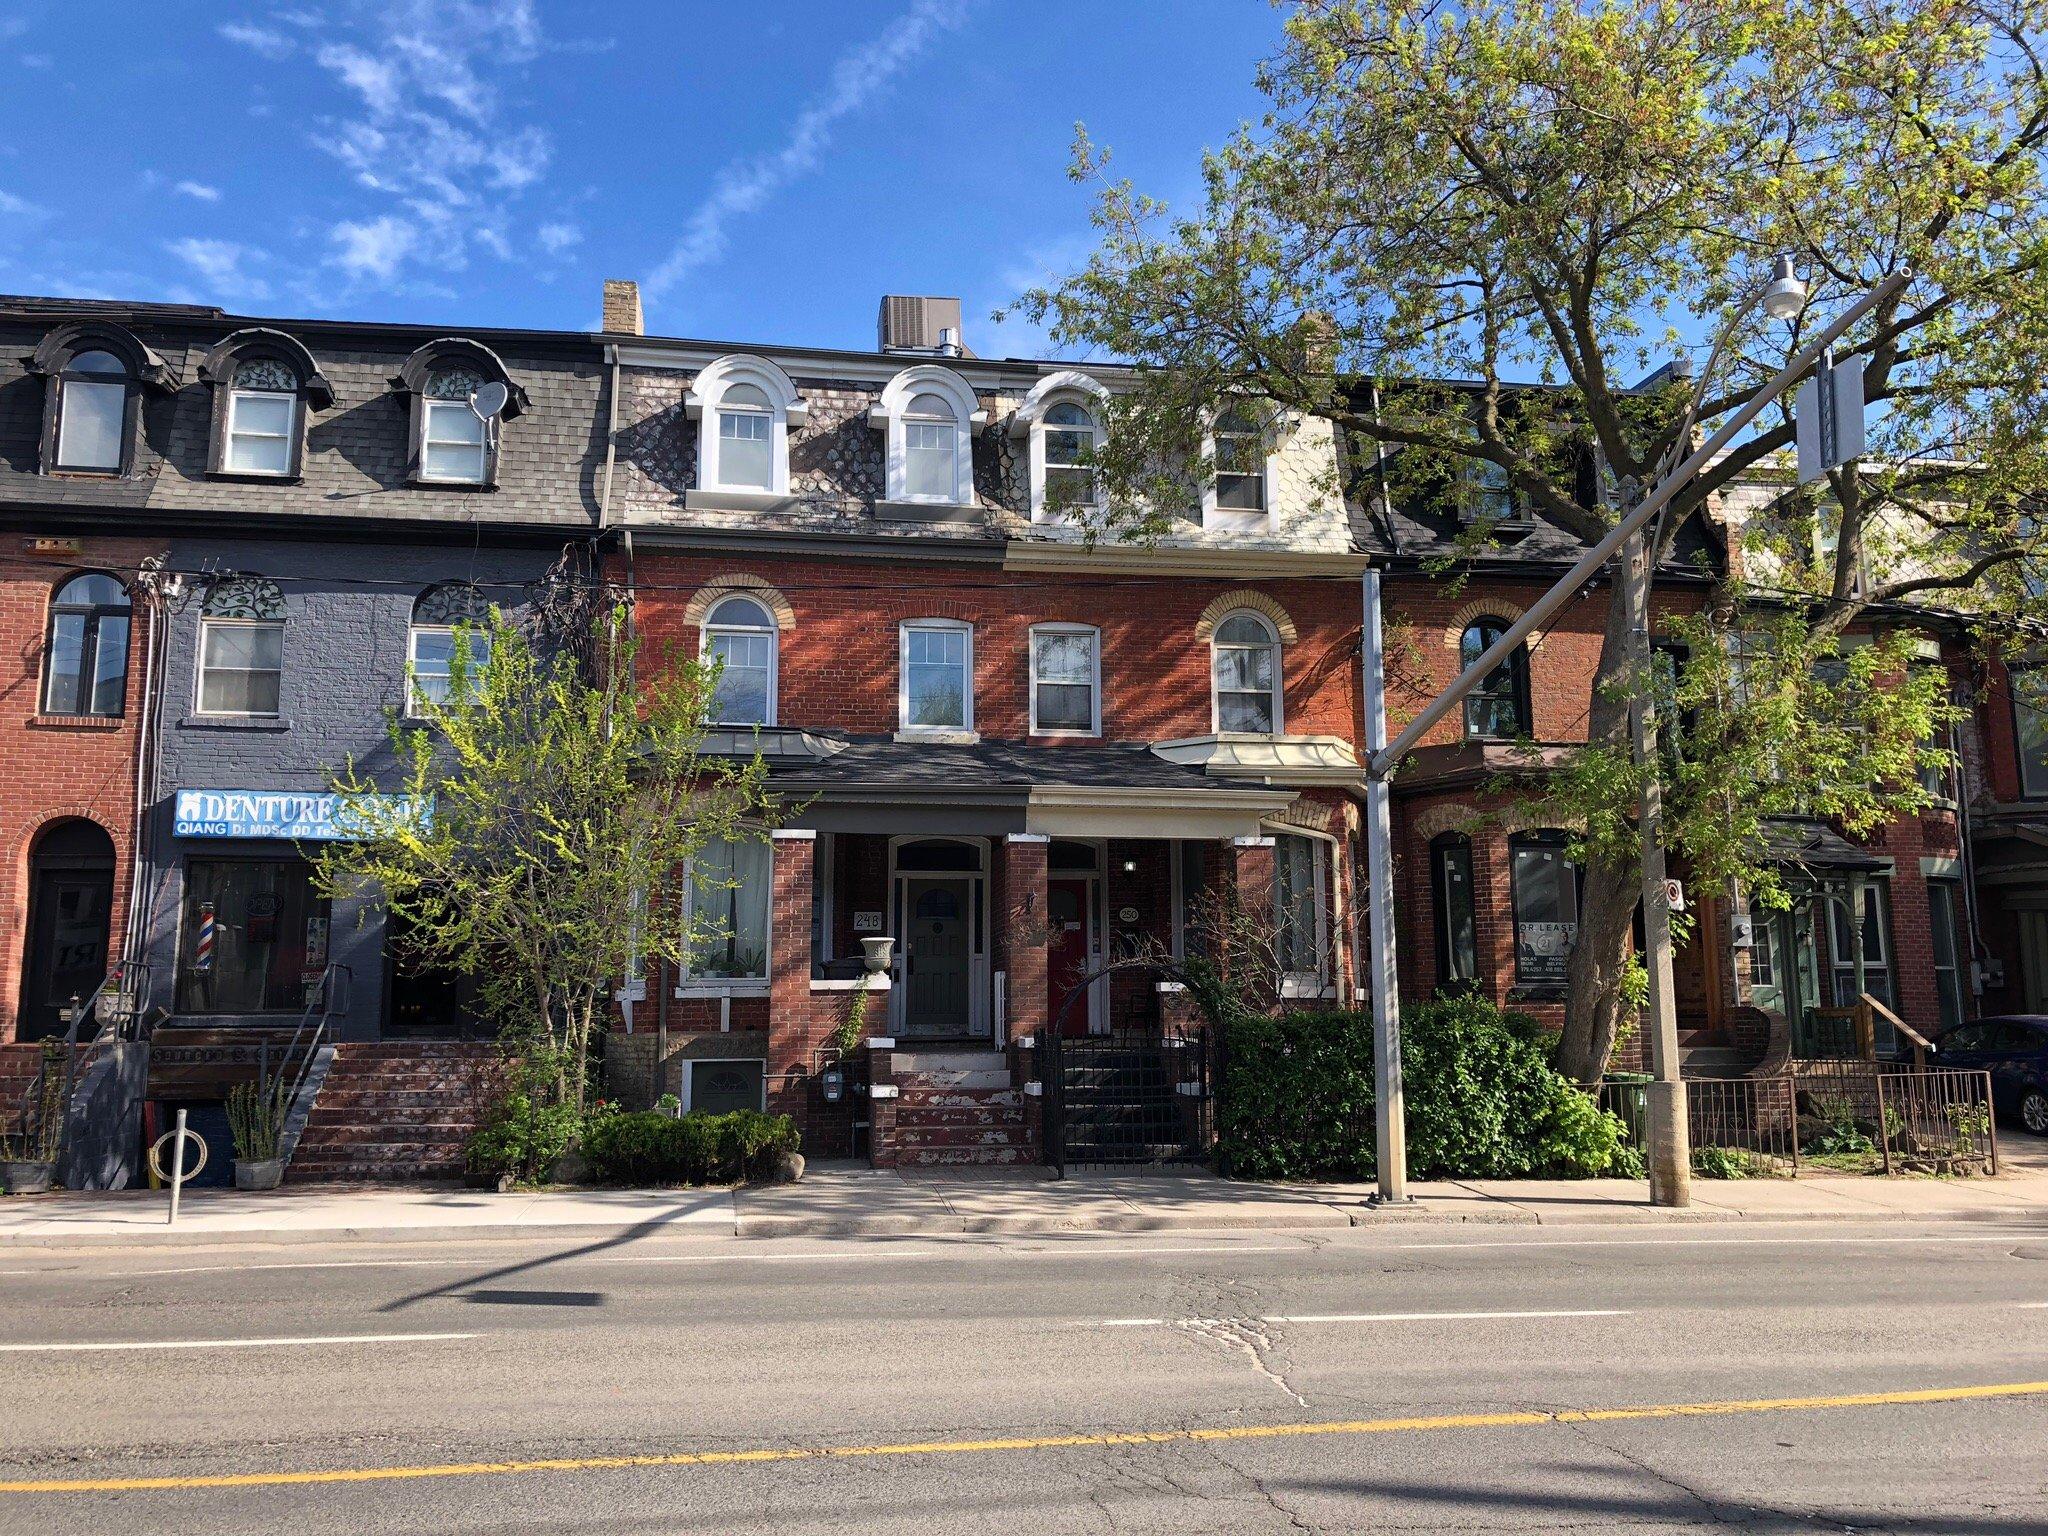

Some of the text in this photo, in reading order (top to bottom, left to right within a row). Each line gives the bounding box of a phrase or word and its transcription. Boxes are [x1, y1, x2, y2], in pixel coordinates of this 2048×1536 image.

[205, 794, 334, 824] DENTURE
[177, 822, 227, 835] QIANG
[232, 825, 246, 836] Di
[249, 825, 287, 837] MDSc
[291, 826, 310, 837] DD
[857, 914, 879, 927] 248
[1121, 910, 1137, 918] 250
